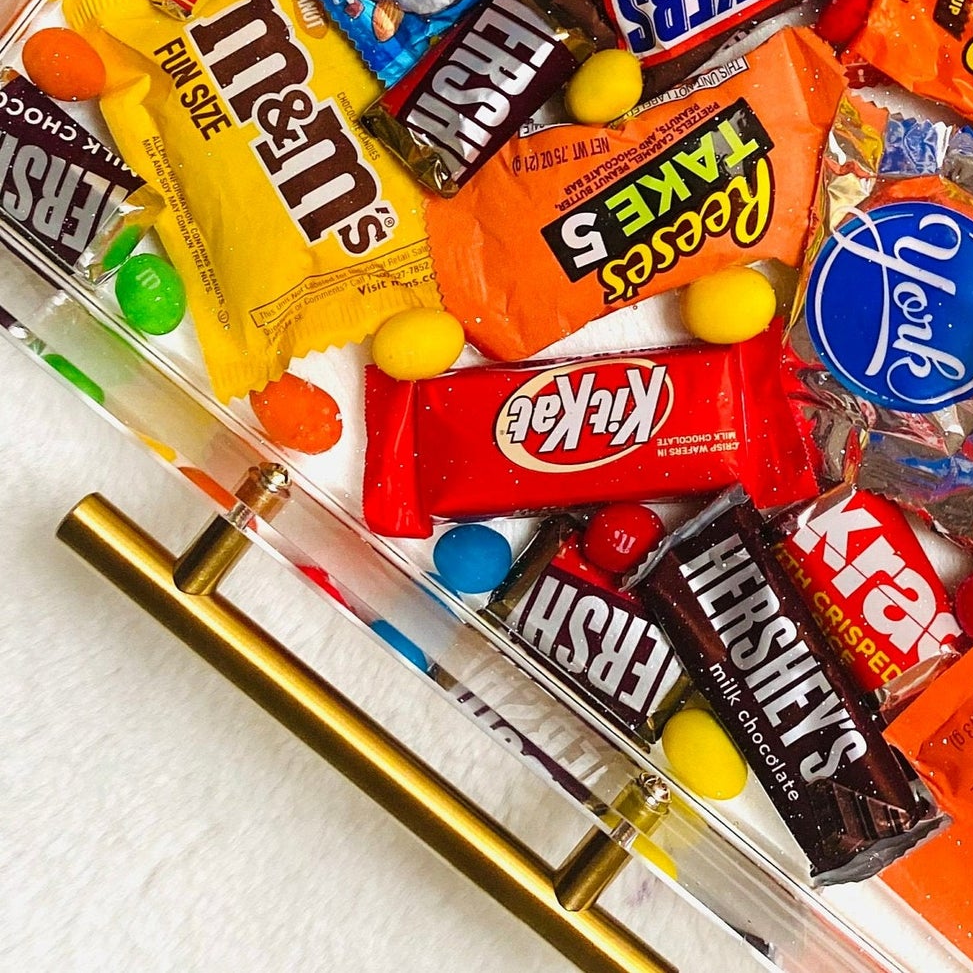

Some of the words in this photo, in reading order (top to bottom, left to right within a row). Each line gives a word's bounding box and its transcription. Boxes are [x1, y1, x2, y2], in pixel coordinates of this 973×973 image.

[693, 70, 719, 91] UNIT
[716, 56, 743, 79] THIS
[153, 37, 200, 85] FUN
[179, 83, 232, 142] SIZE
[671, 81, 695, 101] NOT
[334, 90, 364, 132] CHOCOLATE
[356, 130, 381, 162] CANDIES
[651, 101, 702, 136] PEANUTS,
[668, 99, 722, 137] PRETZELS,
[567, 140, 590, 161] WT
[586, 133, 612, 158] NET
[624, 130, 676, 167] CARAMEL,
[634, 131, 658, 151] AND
[535, 150, 555, 170] OZ
[580, 145, 639, 184] CHOCOLATE
[562, 178, 584, 196] BAR
[590, 161, 631, 189] PEANUT
[609, 120, 762, 236] TAKE
[552, 183, 594, 213] BUTTER,
[151, 159, 165, 177] AND
[167, 195, 180, 213] MAY
[190, 248, 205, 270] TREE
[561, 210, 613, 268] 5
[604, 157, 773, 305] Reese's
[189, 227, 211, 267] CONTAINS
[357, 277, 387, 296] Visit
[833, 206, 966, 405] York
[655, 433, 711, 446] CHOCOLATE
[669, 444, 708, 456] WAFERS
[709, 440, 739, 452] CRISP
[713, 430, 736, 441] MILK
[656, 448, 667, 457] IN
[679, 532, 867, 783] HERSHEY'S
[708, 662, 742, 707] milk
[738, 709, 799, 801] chocolate
